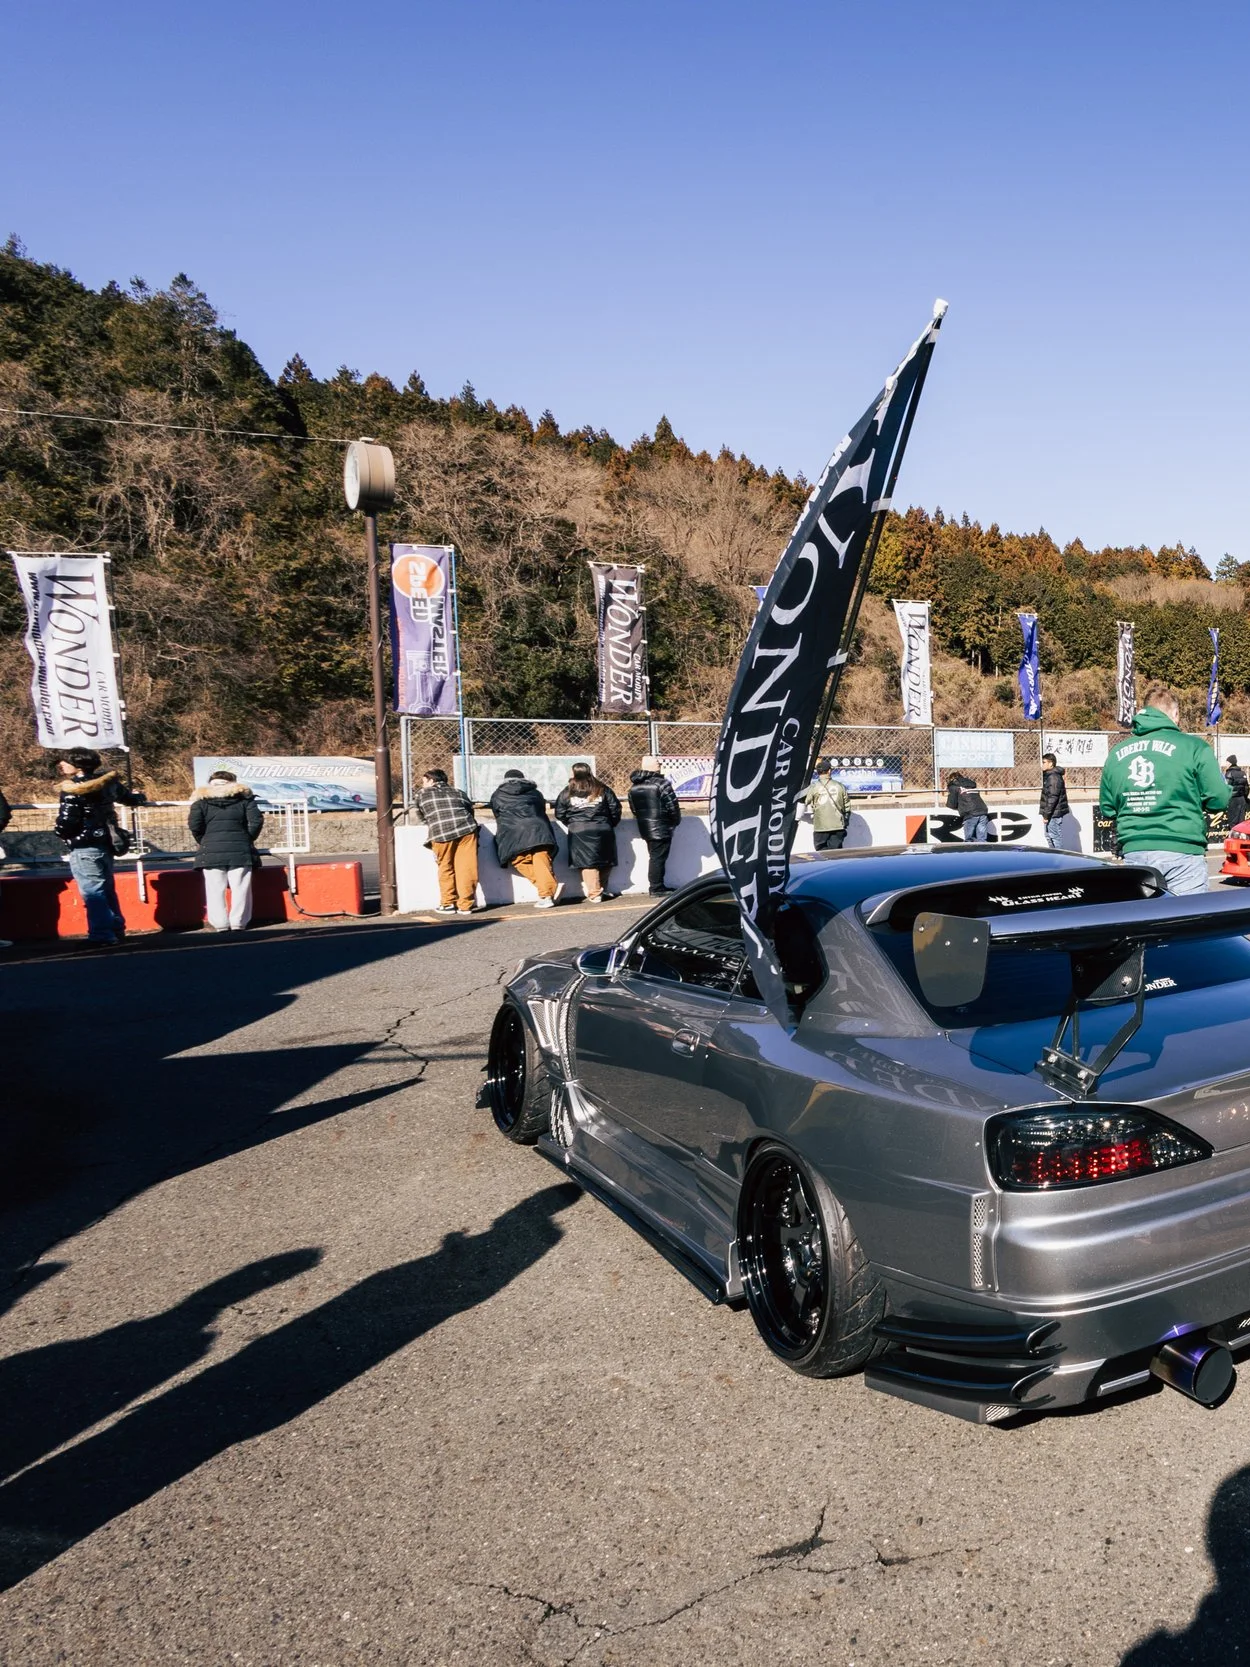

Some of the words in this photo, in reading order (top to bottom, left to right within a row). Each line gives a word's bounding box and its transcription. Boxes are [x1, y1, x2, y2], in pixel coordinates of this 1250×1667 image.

[44, 572, 99, 738] WONDER
[607, 578, 638, 705] WONDER
[906, 612, 926, 717] WONDER
[773, 717, 800, 779] CAR
[1115, 740, 1150, 762] LIBERTY
[1151, 738, 1177, 757] WALK
[768, 786, 788, 898] MODIFY
[1001, 897, 1045, 907] GLASS
